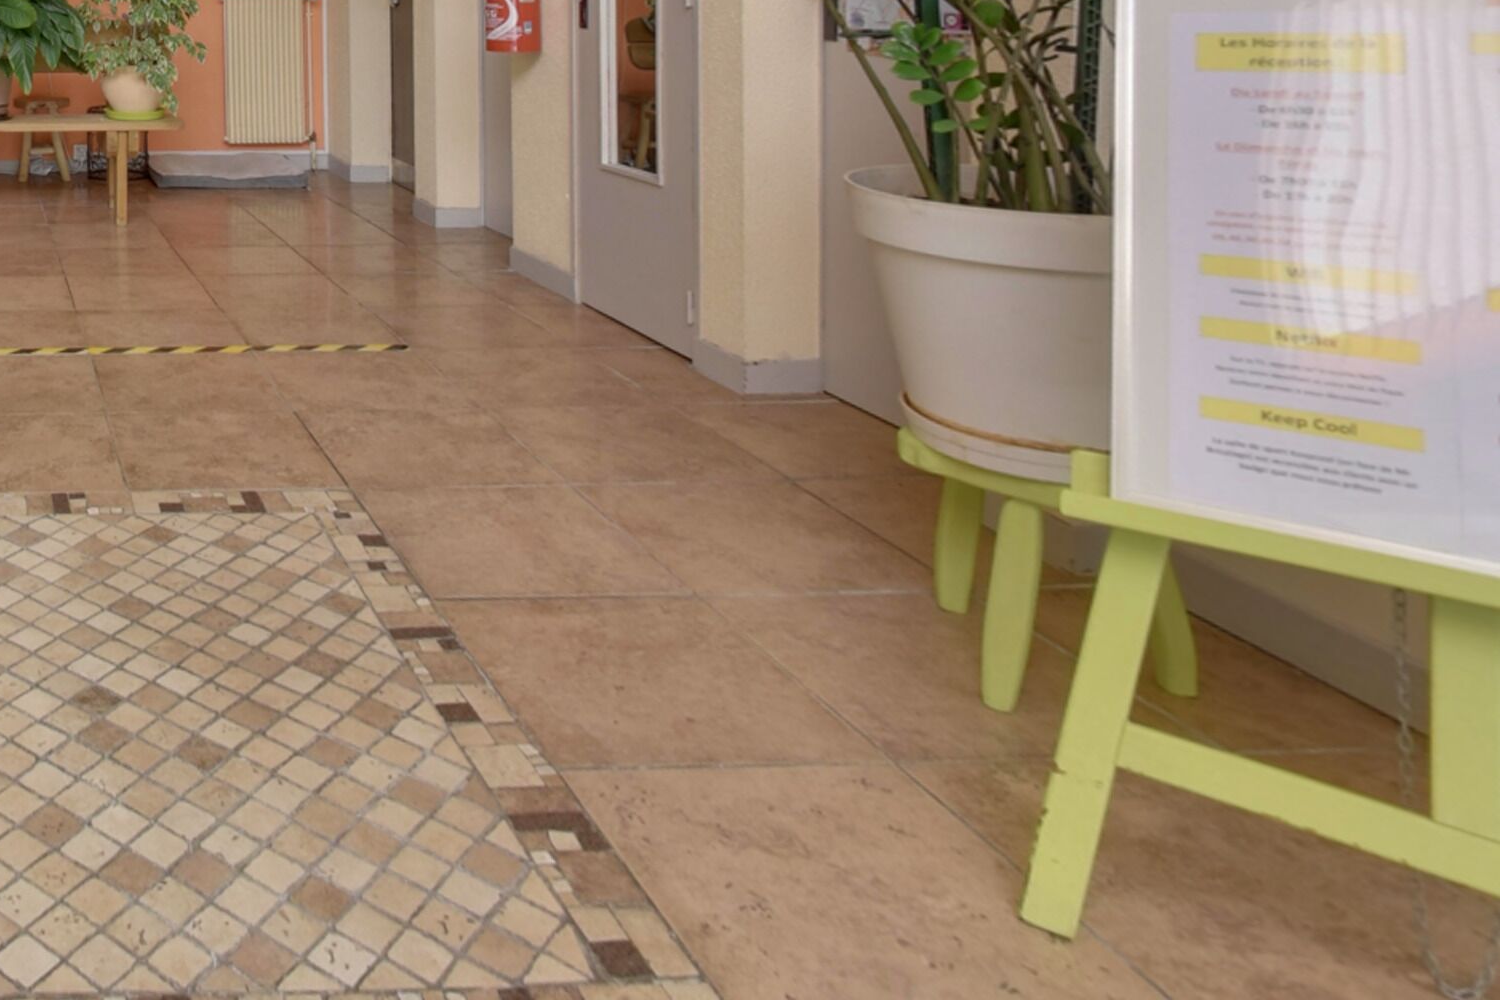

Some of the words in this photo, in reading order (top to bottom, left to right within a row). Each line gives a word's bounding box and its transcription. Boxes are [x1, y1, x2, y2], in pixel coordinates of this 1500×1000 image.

[1219, 37, 1247, 48] Les
[1260, 409, 1309, 430] Keep
[1312, 416, 1359, 437] Cool
